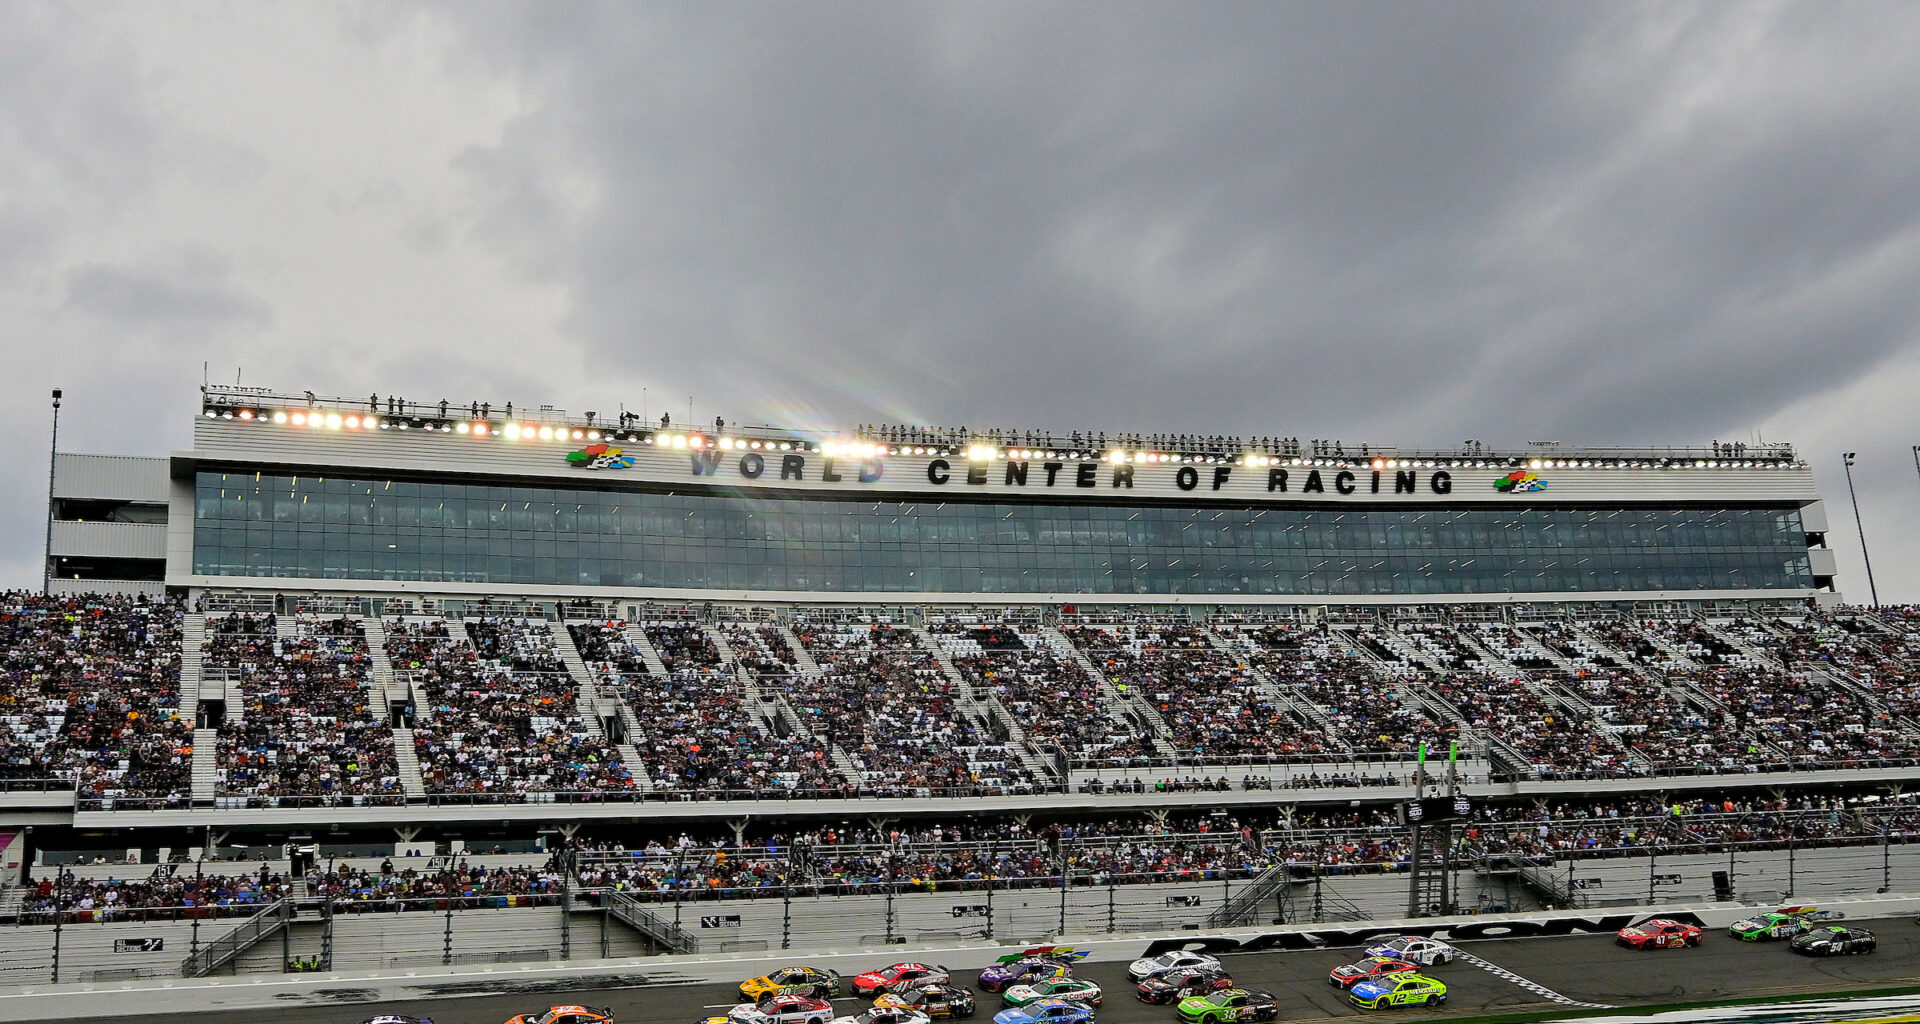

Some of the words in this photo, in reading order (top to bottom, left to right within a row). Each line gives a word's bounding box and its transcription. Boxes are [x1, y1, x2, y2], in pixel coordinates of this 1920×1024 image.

[691, 449, 884, 483] WORLD
[927, 458, 1135, 489] CENTER
[1176, 466, 1232, 491] OF
[1267, 468, 1452, 495] RACING
[431, 857, 445, 869] 150
[157, 865, 171, 878] 151
[1656, 935, 1666, 945] 47
[1829, 941, 1844, 952] 54
[1069, 990, 1094, 1000] Castrol
[1176, 987, 1193, 1000] 45
[1392, 993, 1408, 1004] 12
[1062, 1012, 1089, 1021] CARVANA
[1223, 1008, 1237, 1020] 38
